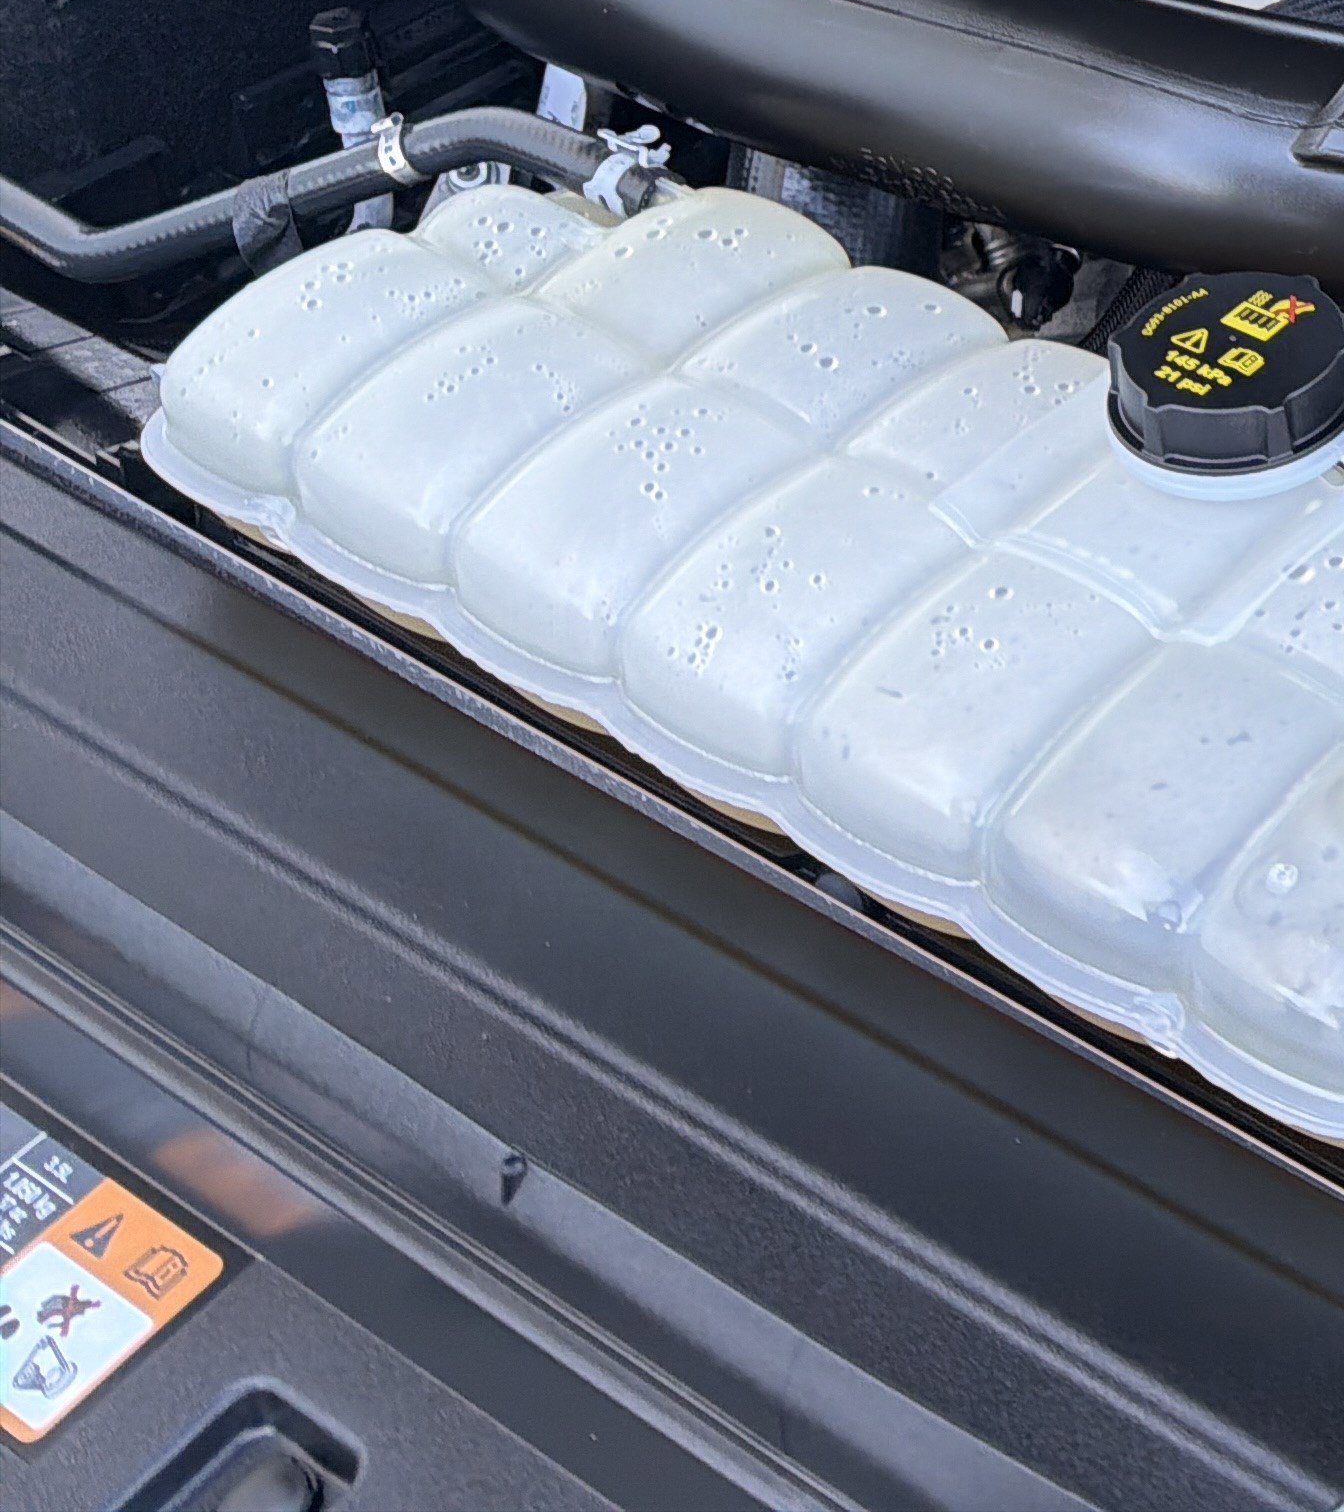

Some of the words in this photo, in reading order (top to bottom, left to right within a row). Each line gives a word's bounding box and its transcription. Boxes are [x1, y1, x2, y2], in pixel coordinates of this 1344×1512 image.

[1154, 365, 1182, 382] 21
[1176, 378, 1212, 396] psi
[1165, 350, 1201, 371] 145
[1196, 363, 1233, 387] kPa
